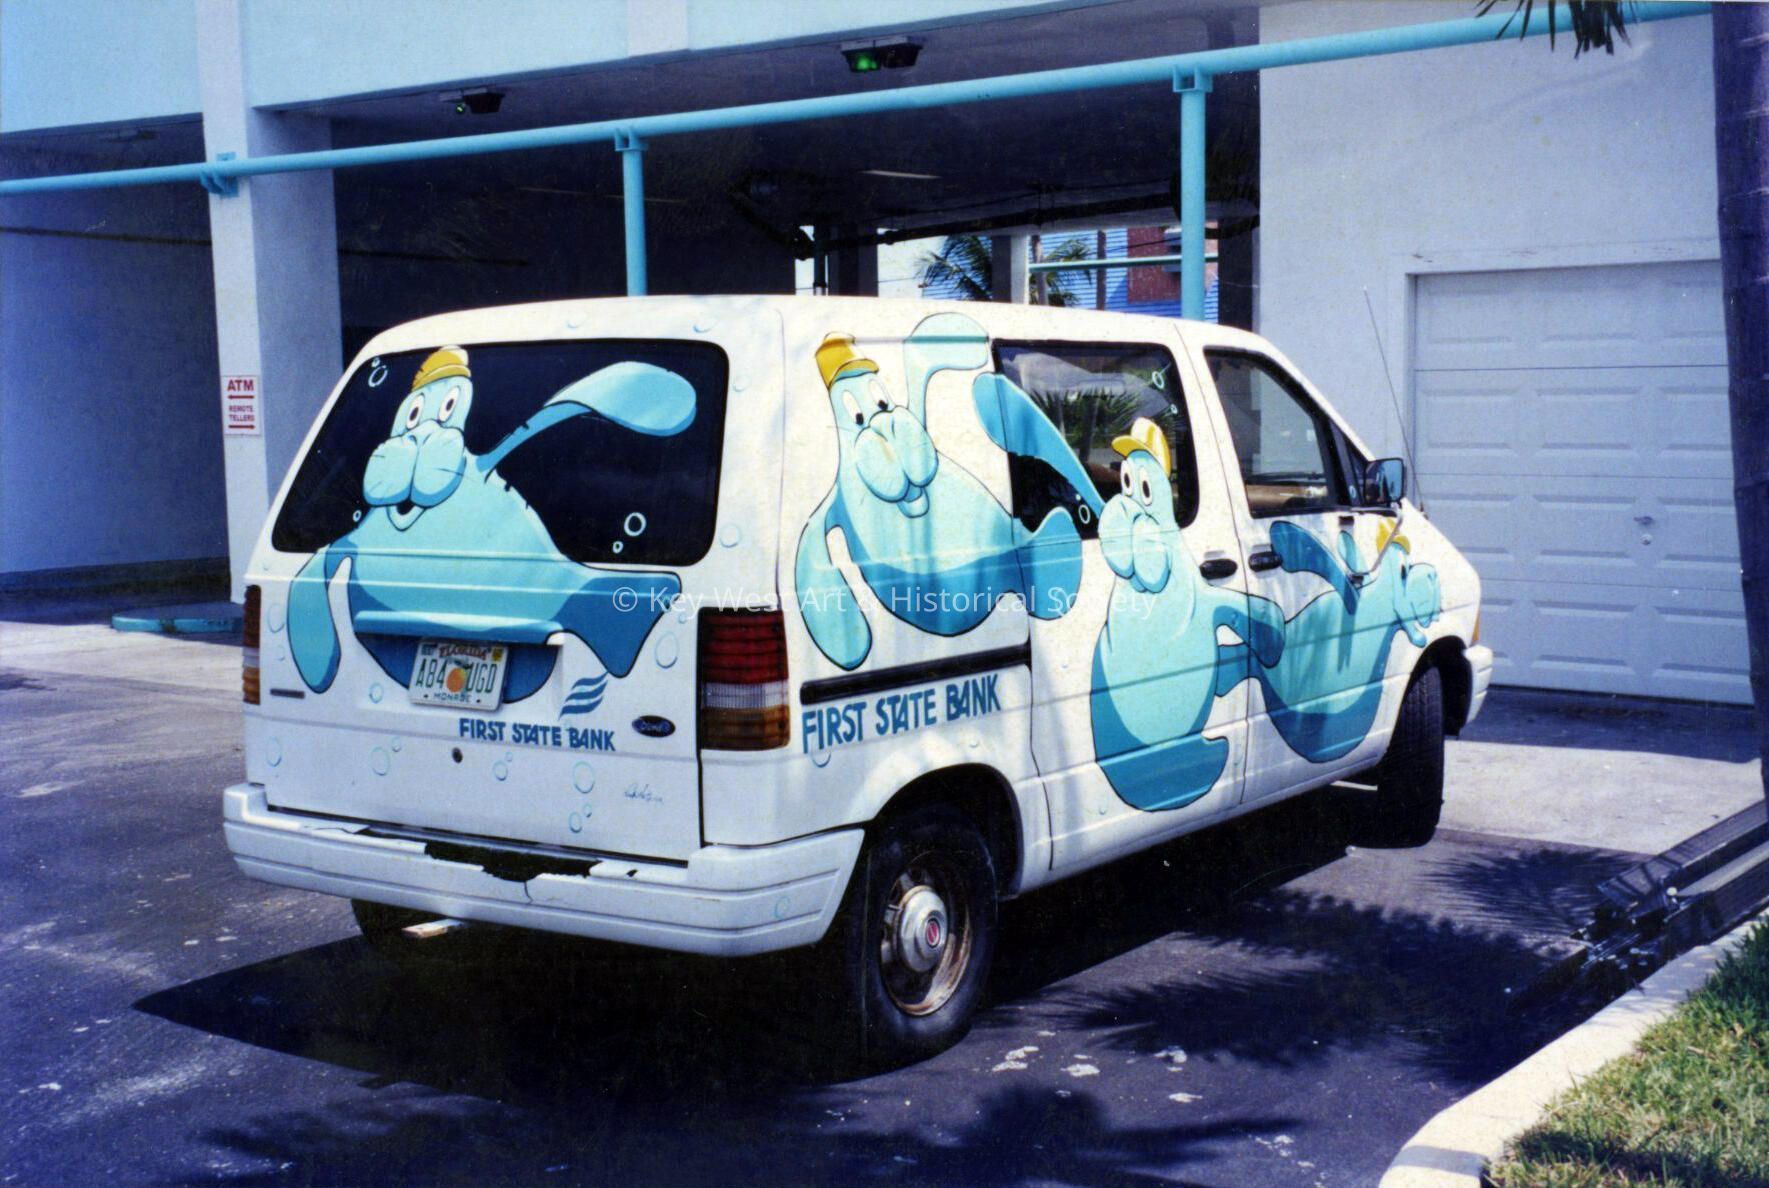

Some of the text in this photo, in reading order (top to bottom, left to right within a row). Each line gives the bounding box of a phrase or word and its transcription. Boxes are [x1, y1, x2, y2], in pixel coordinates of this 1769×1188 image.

[227, 379, 254, 391] ATM
[229, 414, 255, 422] TELLERS
[802, 674, 1001, 754] FIRST STATE BANK
[459, 718, 616, 751] FIRST STATE BANK
